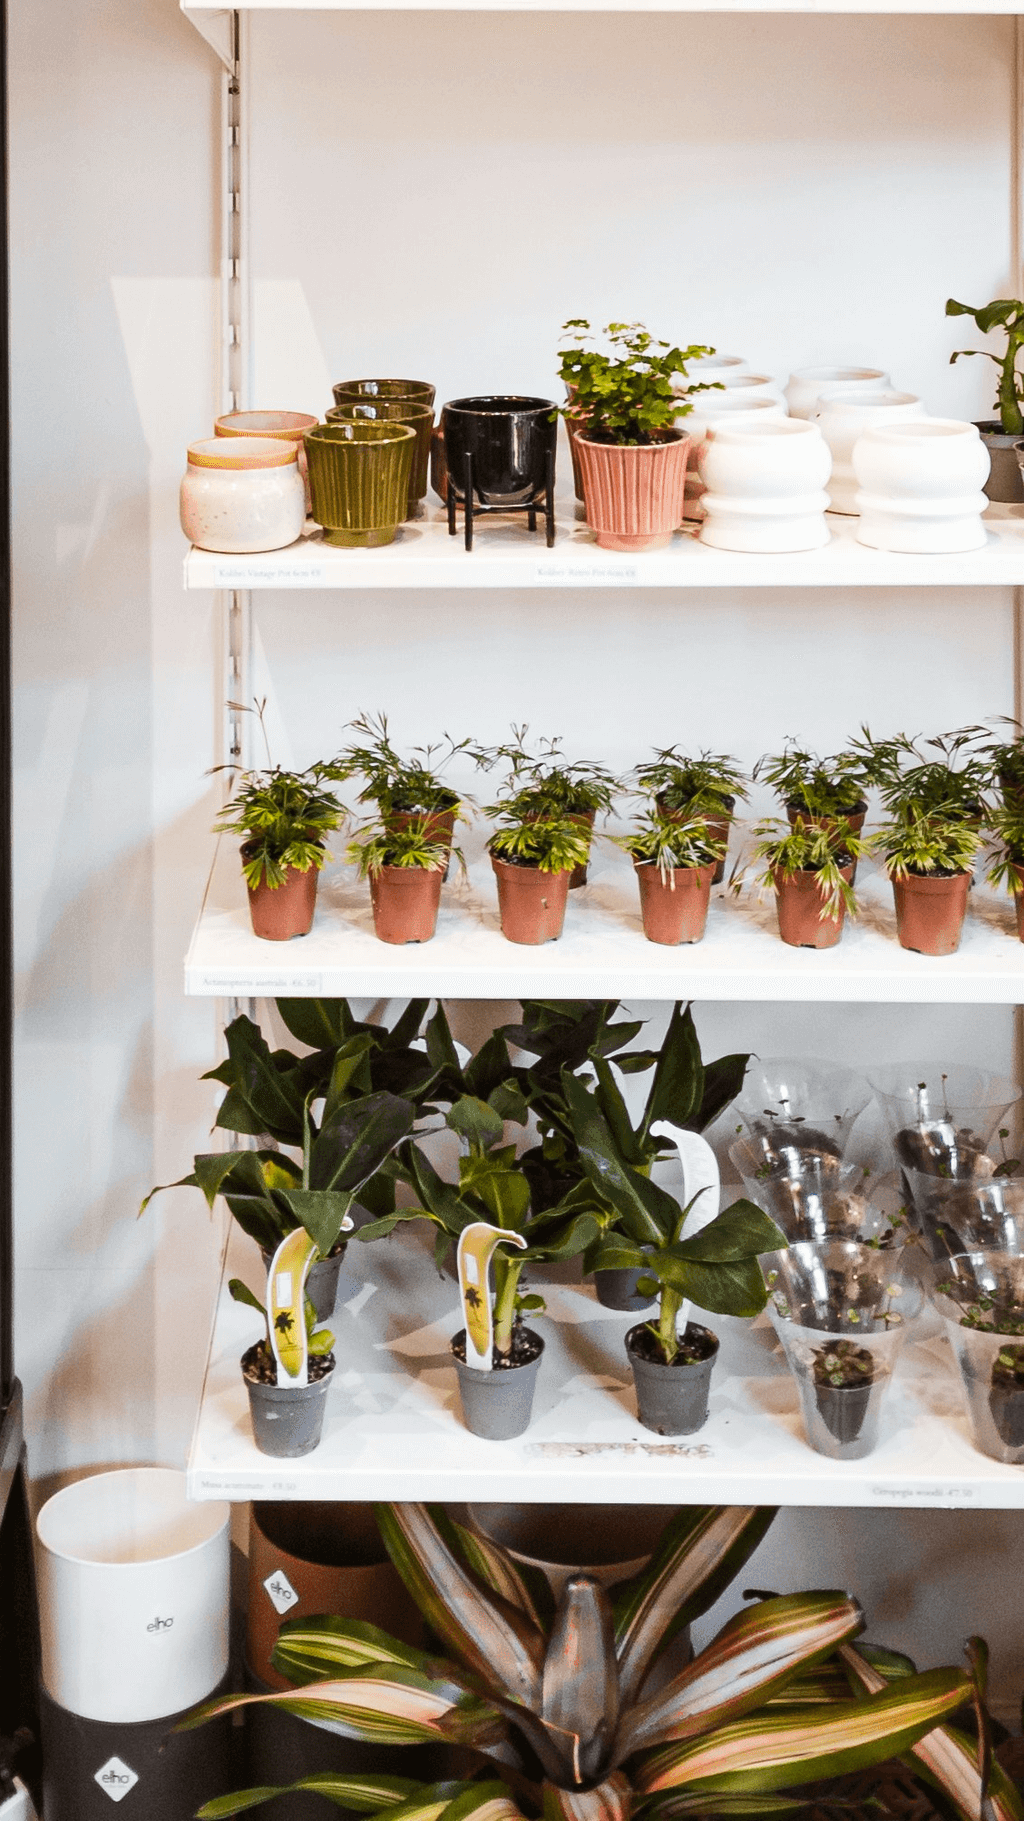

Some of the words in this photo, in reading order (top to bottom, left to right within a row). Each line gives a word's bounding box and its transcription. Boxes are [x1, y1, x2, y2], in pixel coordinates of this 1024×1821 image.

[270, 1580, 292, 1601] elho
[146, 1615, 174, 1633] elho
[101, 1769, 130, 1784] elho
